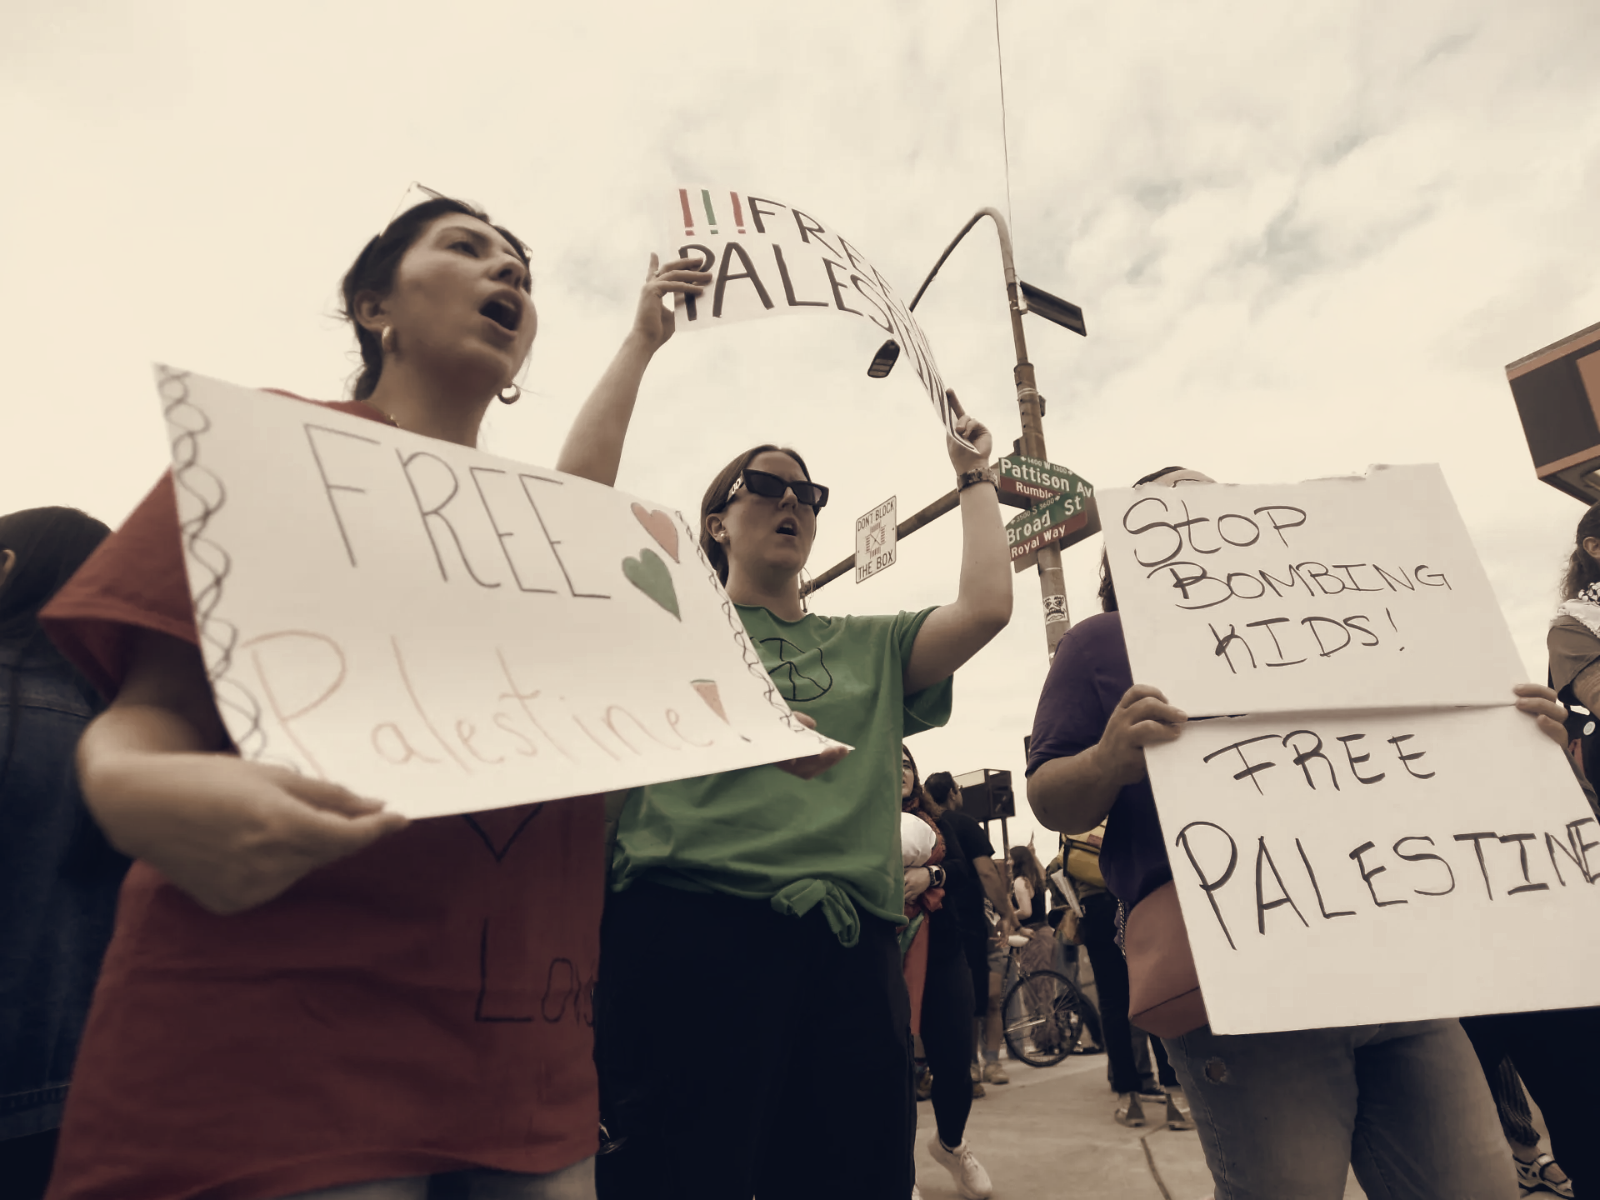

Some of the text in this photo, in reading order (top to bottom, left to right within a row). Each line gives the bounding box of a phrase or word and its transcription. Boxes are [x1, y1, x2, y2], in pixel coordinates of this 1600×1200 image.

[1001, 458, 1092, 498] Pattison Av
[1044, 462, 1051, 470] W
[303, 423, 611, 600] FREE
[875, 500, 894, 521] BLOCK
[1007, 495, 1082, 546] Broad St
[1032, 506, 1038, 515] S
[1011, 524, 1066, 558] Royal Way
[858, 549, 893, 580] THE BOX
[1146, 560, 1453, 610] BOMBING
[1207, 606, 1406, 674] KIDS!
[1203, 729, 1436, 796] FREE
[1175, 816, 1600, 951] PALESTINE
